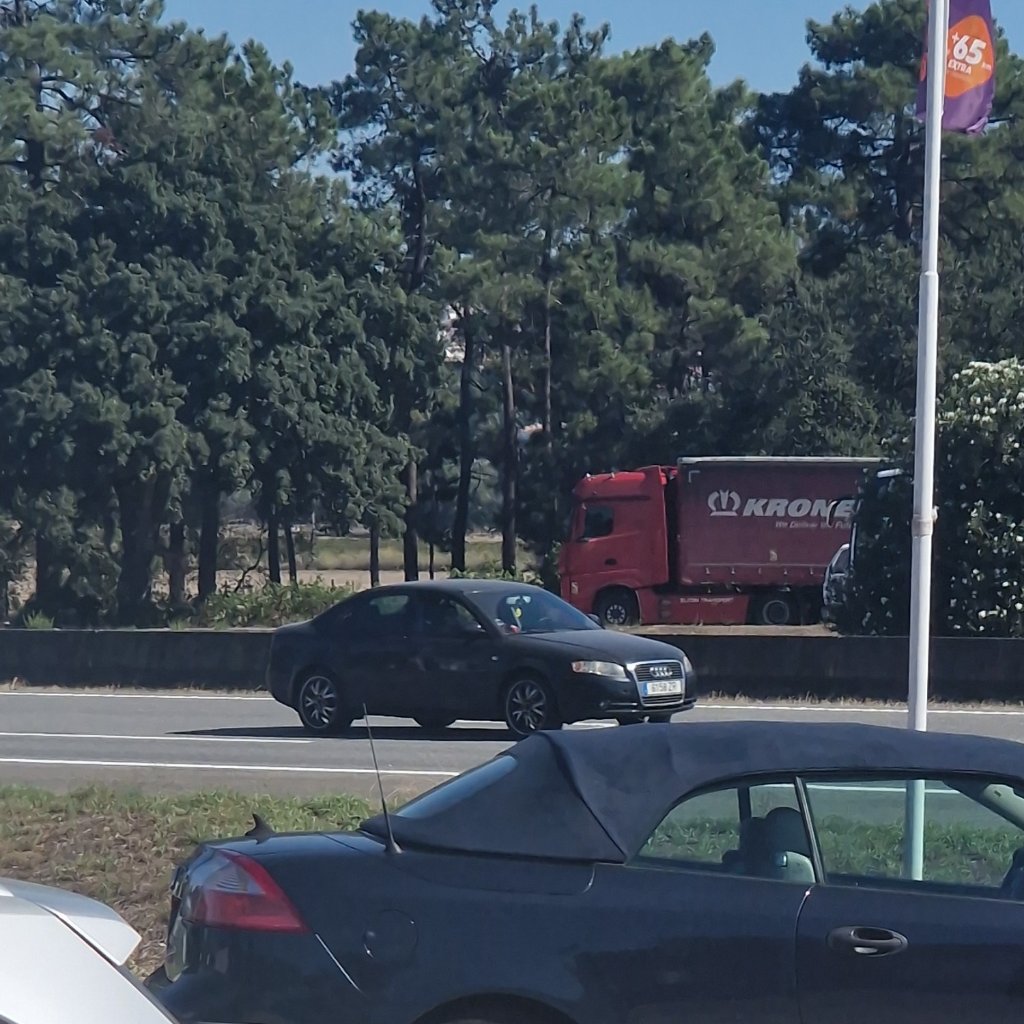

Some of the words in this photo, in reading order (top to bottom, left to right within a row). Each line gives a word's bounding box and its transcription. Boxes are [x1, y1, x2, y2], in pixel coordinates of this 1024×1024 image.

[951, 31, 987, 65] +65
[947, 59, 971, 75] EXTRA
[742, 498, 857, 518] KRONE
